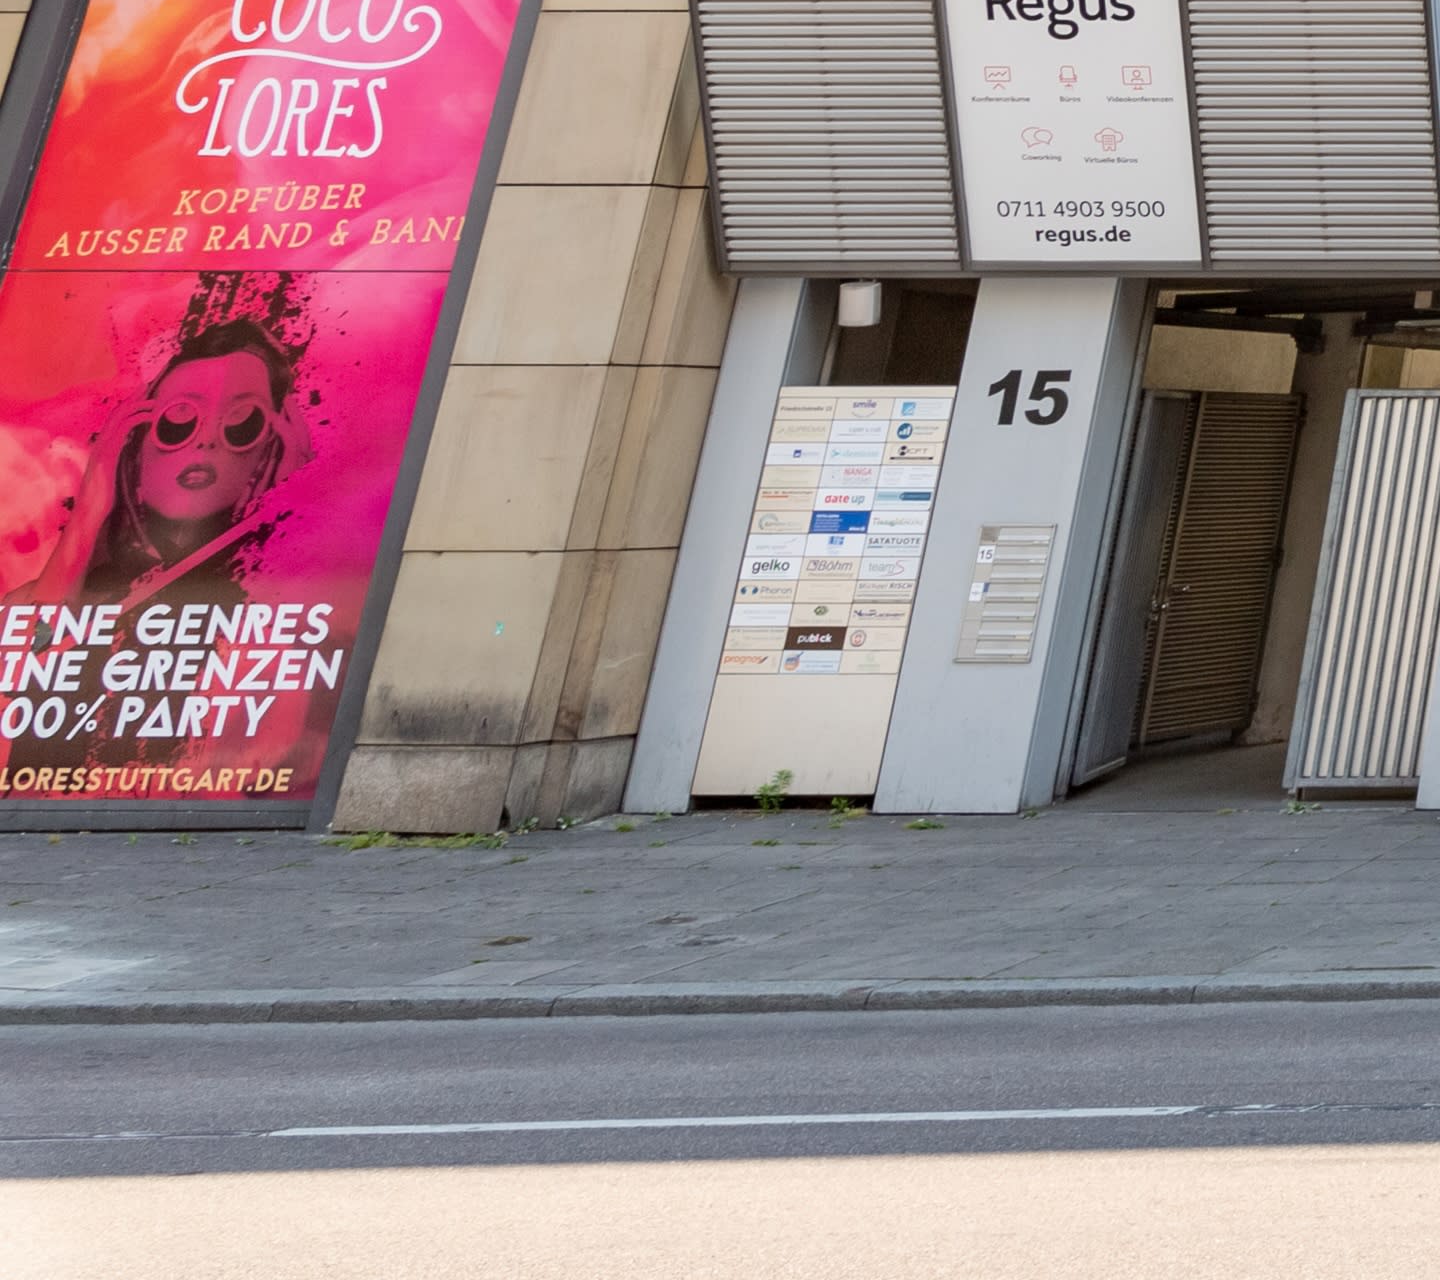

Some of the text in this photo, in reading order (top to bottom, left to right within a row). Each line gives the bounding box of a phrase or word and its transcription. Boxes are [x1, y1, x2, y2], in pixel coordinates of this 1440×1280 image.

[197, 76, 388, 158] LORES
[172, 180, 367, 217] KOPFÜBER
[996, 200, 1166, 218] 0711 4903 9500
[44, 225, 188, 258] AUSSER
[202, 221, 313, 252] RAND
[328, 219, 350, 247] &
[1035, 226, 1132, 246] regus.de
[988, 368, 1073, 426] 15
[824, 493, 850, 504] date
[851, 494, 865, 505] up
[752, 558, 790, 574] gelko
[980, 549, 993, 560] 15
[0, 604, 335, 646] ENE GENRES
[0, 649, 345, 692] INE GRENZEN
[113, 695, 277, 738] PARTY
